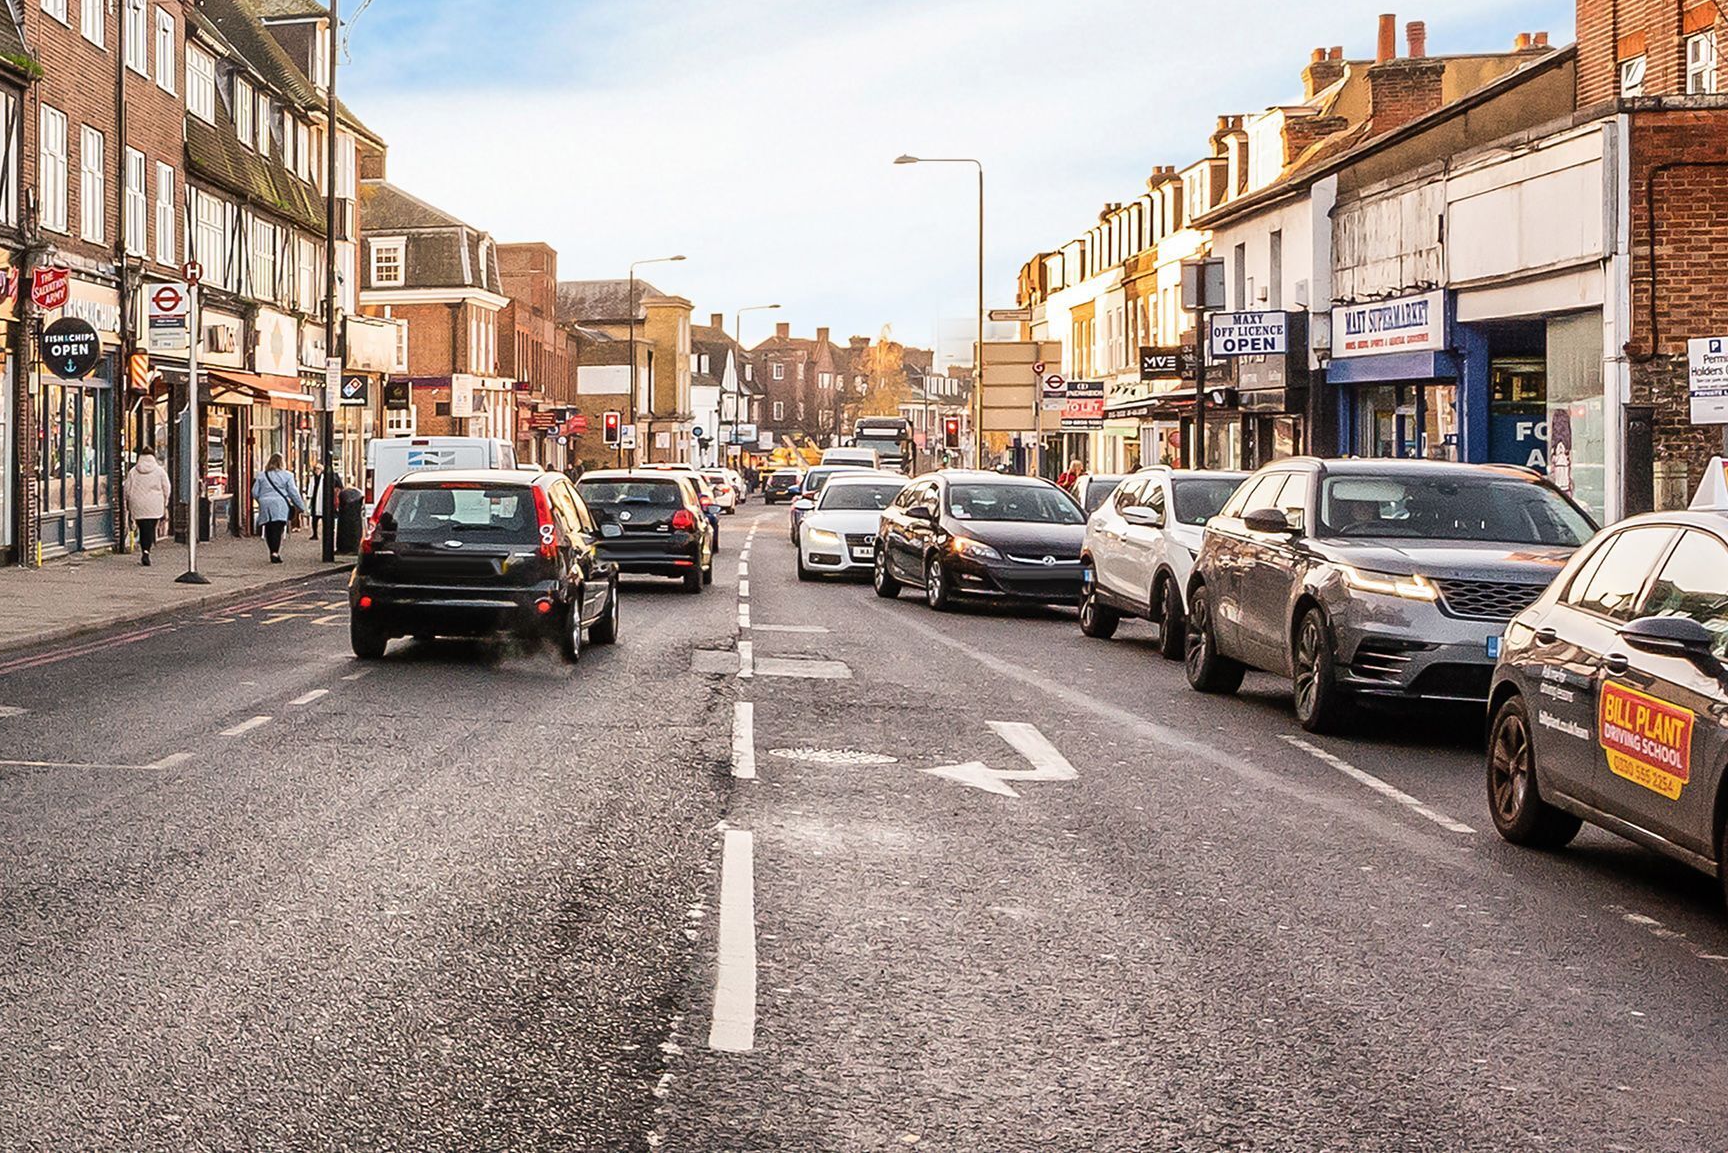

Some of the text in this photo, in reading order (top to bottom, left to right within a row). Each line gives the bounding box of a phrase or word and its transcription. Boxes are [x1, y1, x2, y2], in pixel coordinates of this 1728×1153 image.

[41, 272, 55, 284] THE
[187, 262, 200, 280] H
[34, 279, 66, 299] SALVATION
[45, 289, 65, 305] ARMY
[1233, 314, 1263, 325] MAXY
[1214, 325, 1283, 337] OFF LICENCE
[51, 344, 89, 356] OPEN
[1223, 337, 1275, 352] OPEN
[1691, 366, 1723, 376] Holders
[1604, 693, 1633, 730] BILL
[1636, 706, 1685, 749] PLANT
[1604, 723, 1641, 751] DRIVING
[1642, 737, 1683, 769] SCHOOL
